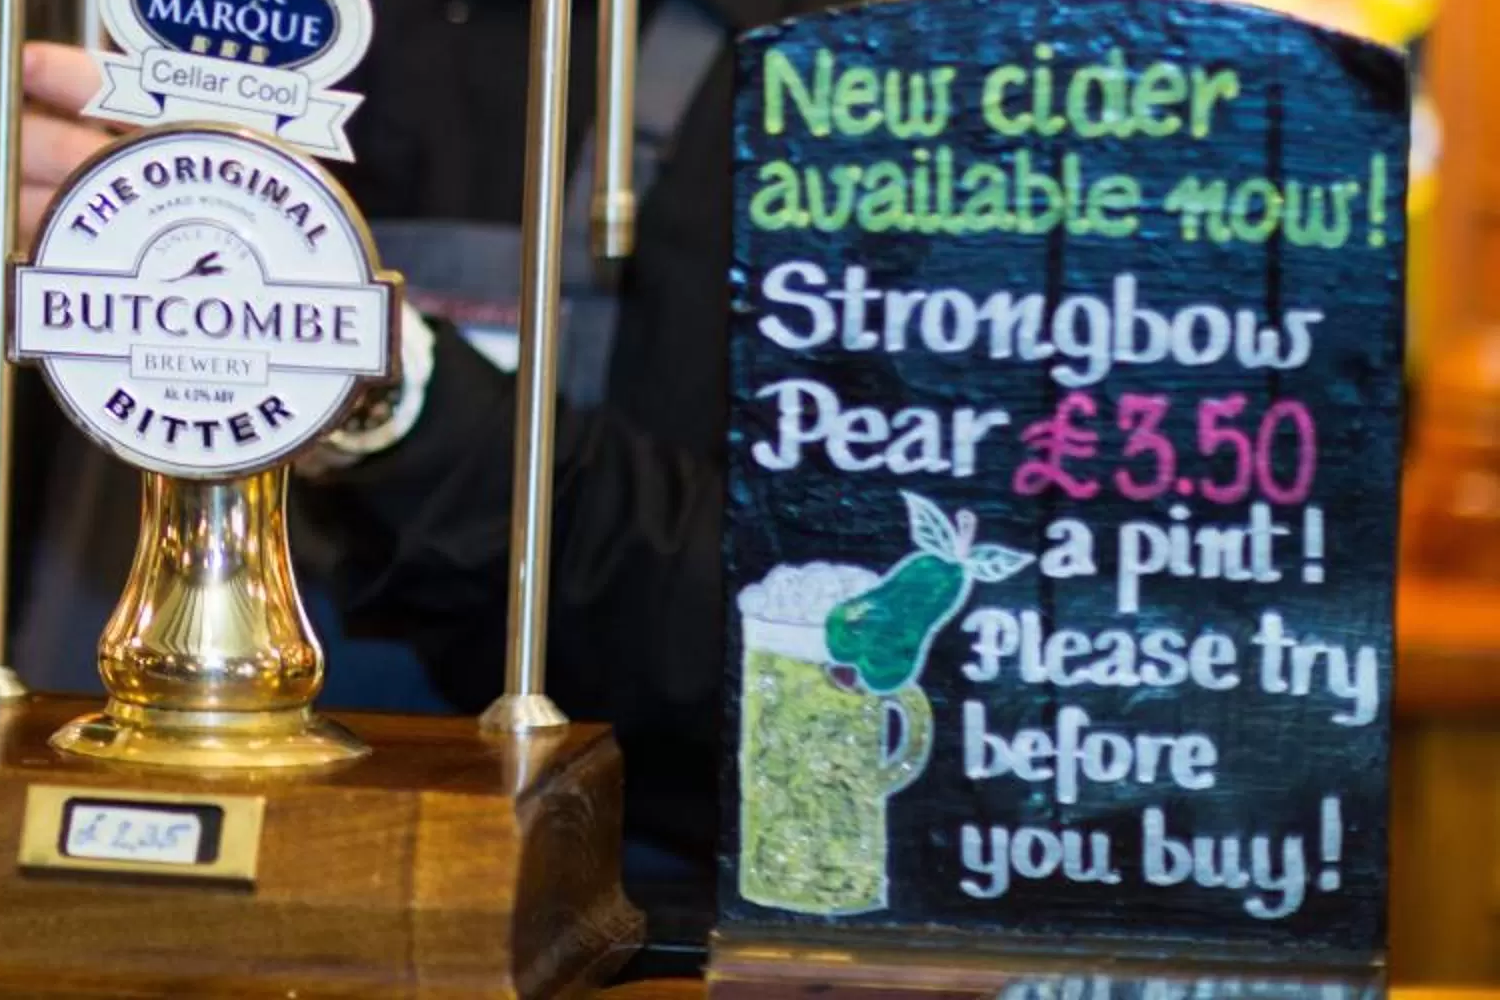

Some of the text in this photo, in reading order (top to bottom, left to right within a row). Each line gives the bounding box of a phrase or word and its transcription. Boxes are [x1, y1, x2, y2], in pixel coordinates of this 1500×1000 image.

[151, 59, 299, 106] Cellar Cool
[762, 42, 1240, 140] New cider
[71, 156, 329, 254] THE ORIGINAL
[749, 146, 1388, 248] available now!
[43, 289, 360, 346] BUTCOMBE
[145, 353, 252, 376] BREWERY
[757, 260, 1325, 388] Strongbow
[104, 388, 296, 449] BITTER
[752, 378, 1318, 504] Pear £3.50
[1039, 502, 1326, 613] a pint!
[961, 607, 1380, 727] Please try
[962, 699, 1219, 805] before
[959, 795, 1343, 920] you buy!
